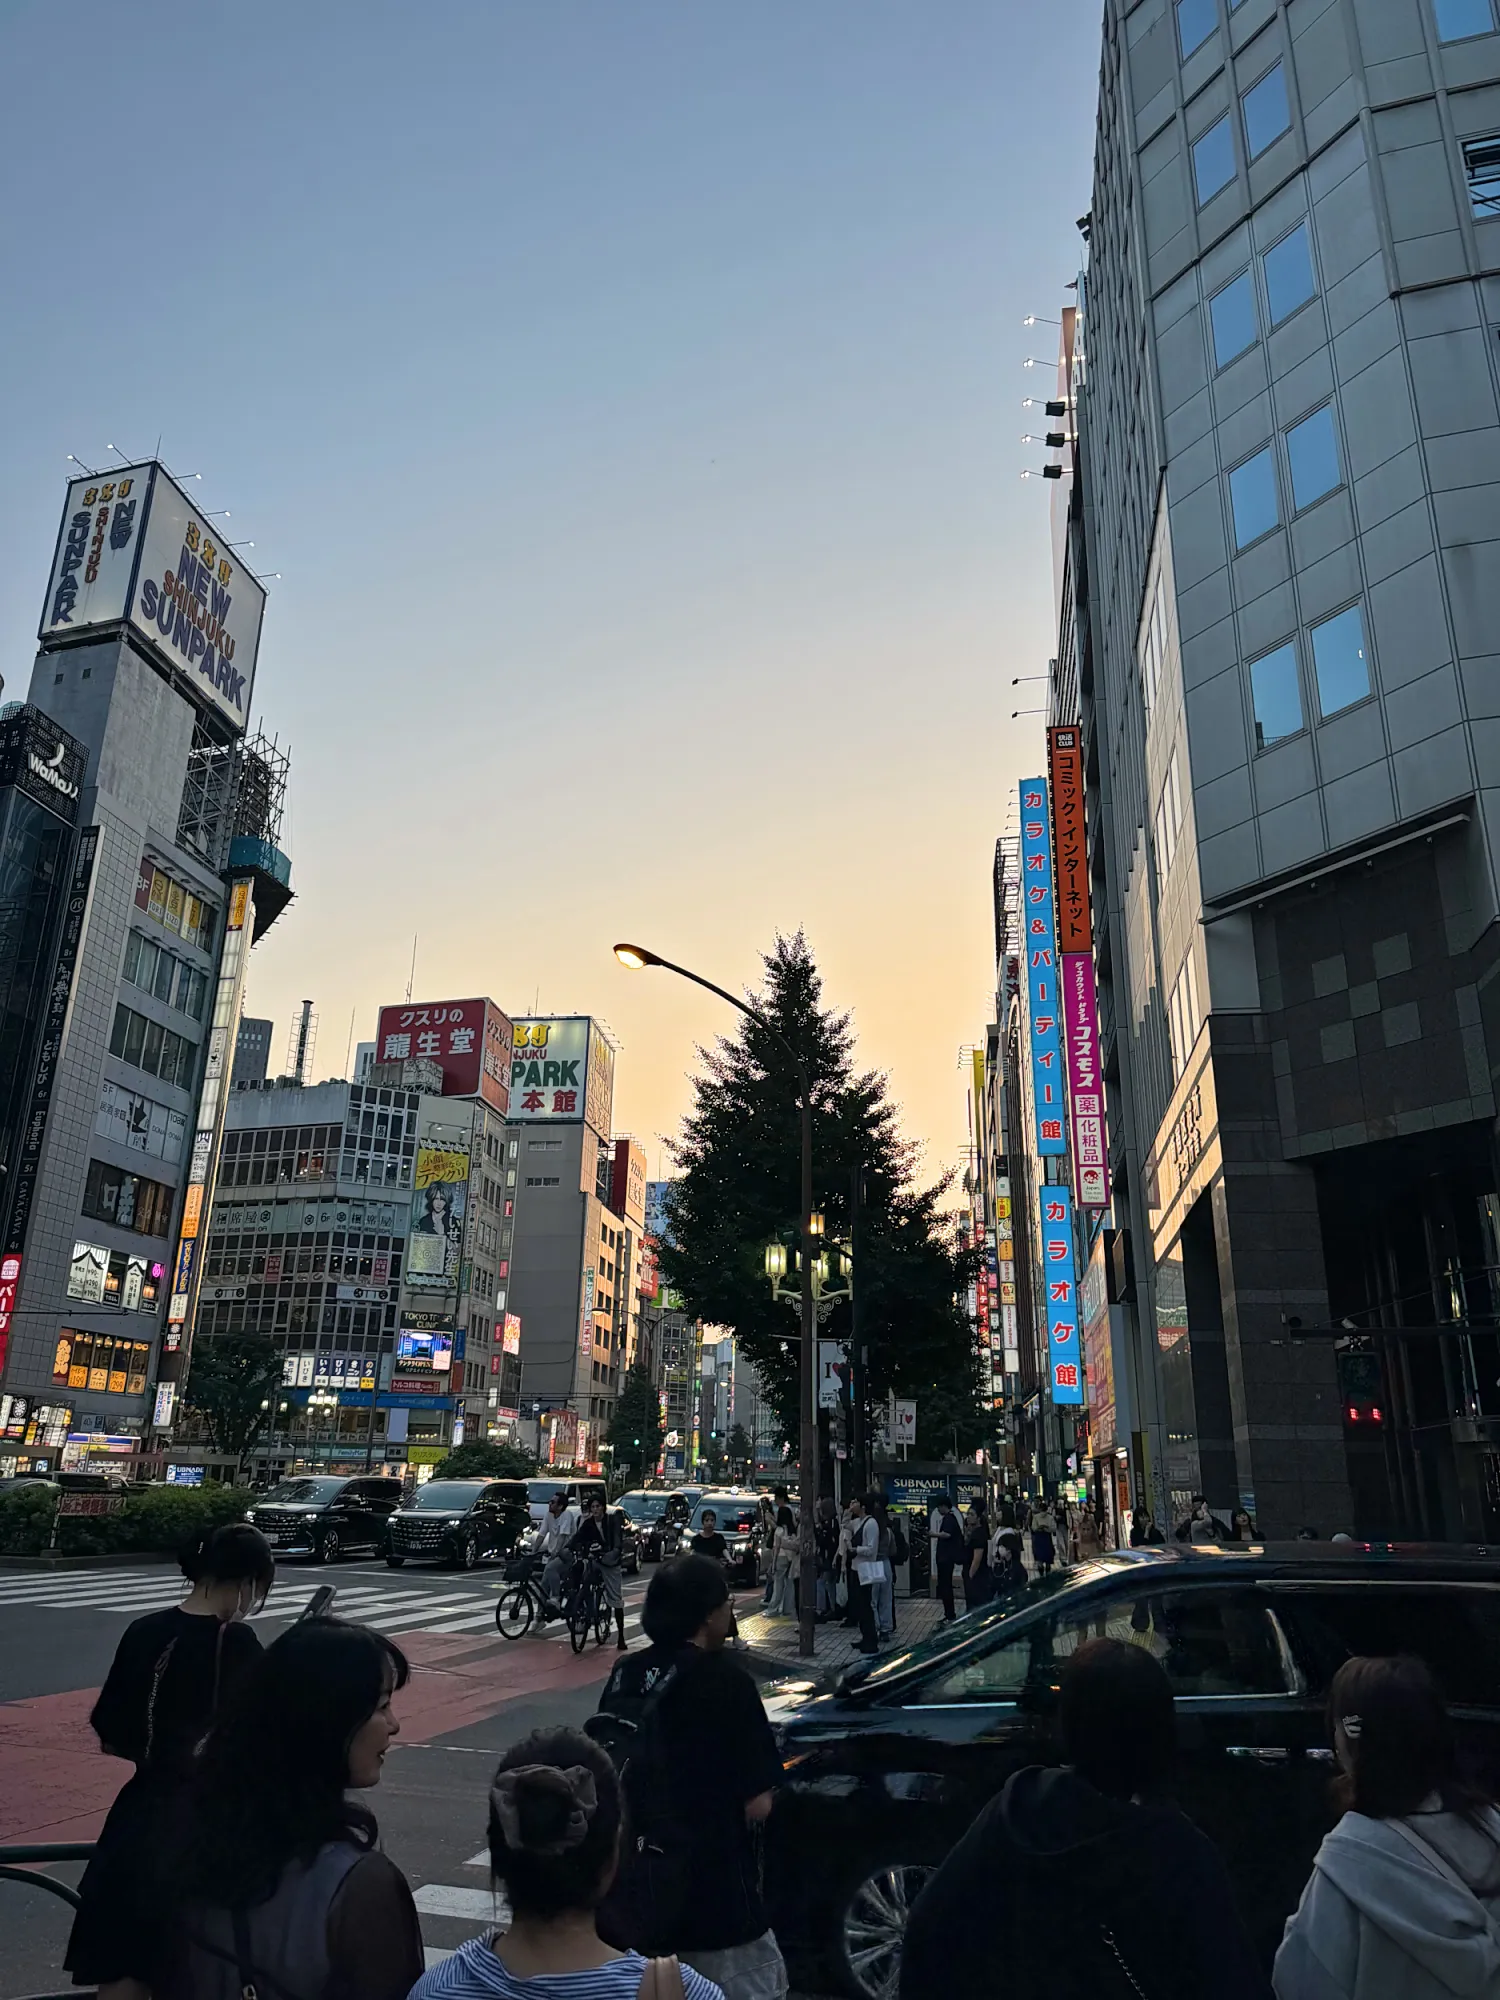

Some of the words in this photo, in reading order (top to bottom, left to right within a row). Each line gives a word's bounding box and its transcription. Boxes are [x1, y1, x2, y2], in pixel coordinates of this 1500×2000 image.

[84, 506, 110, 584] SHINJUKU
[109, 499, 137, 550] NEW
[51, 511, 91, 626] SUNPARK
[177, 544, 233, 625] NEW
[162, 569, 236, 661] SHINJUKU
[140, 578, 247, 712] SUNPARK
[1059, 756, 1083, 938] コミック・インターネット
[399, 1008, 465, 1028] クスリの
[37, 1039, 53, 1086] ともしび
[382, 1028, 476, 1060] 龍生堂
[1073, 1026, 1095, 1088] コスモス
[102, 1084, 114, 1095] 5F
[510, 1060, 581, 1088] PARK
[520, 1089, 578, 1114] 本館
[1078, 1097, 1096, 1113] 薬
[28, 1110, 46, 1151] Euphoria
[1081, 1119, 1099, 1163] 化粧品
[320, 1212, 330, 1222] 6F
[444, 1207, 461, 1275] たいせい先生
[1046, 1202, 1078, 1386] カラオケ館
[404, 1312, 428, 1320] TOKYO
[392, 1380, 422, 1390] トルコ料理
[154, 1391, 164, 1424] SUNPARK
[894, 1478, 946, 1489] SUBNADE
